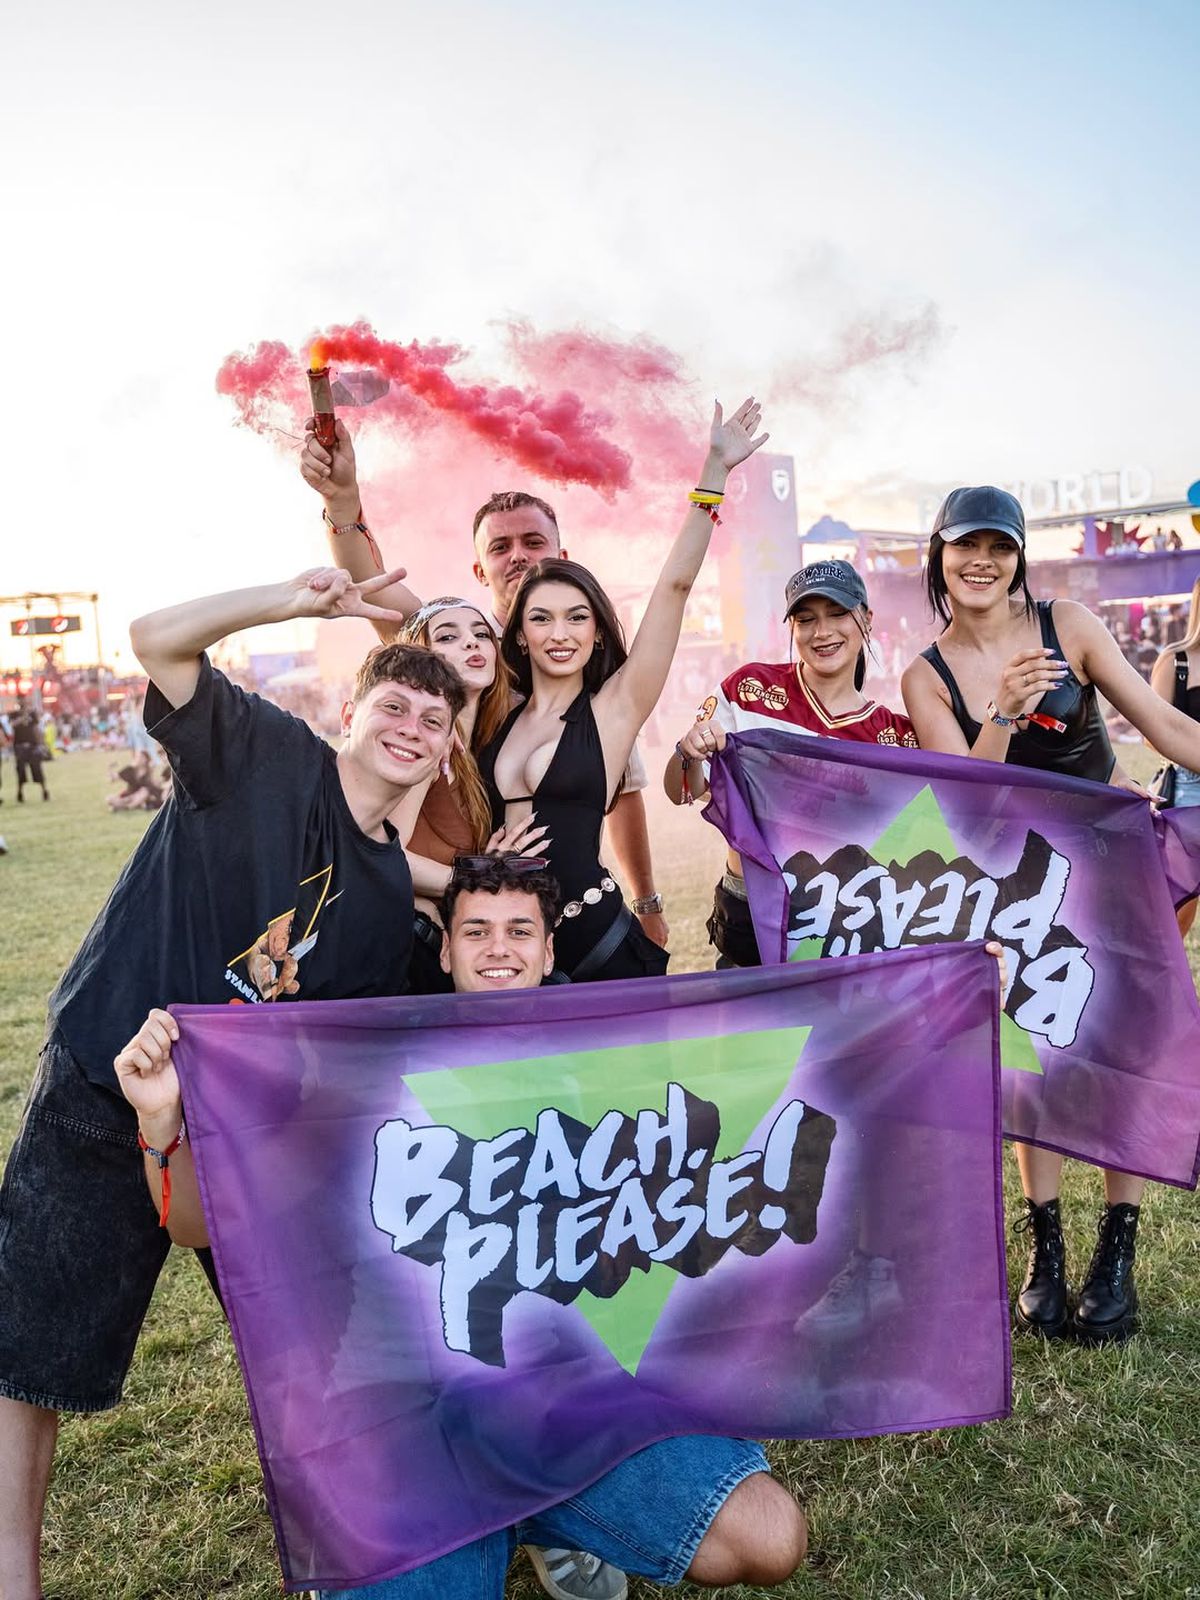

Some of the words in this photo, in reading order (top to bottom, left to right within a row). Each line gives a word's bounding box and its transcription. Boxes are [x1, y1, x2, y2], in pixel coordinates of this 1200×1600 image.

[1006, 463, 1152, 517] ORLD
[880, 735, 894, 743] LOS
[224, 968, 263, 1004] STANL
[371, 1081, 708, 1252] BEACH.
[441, 1100, 806, 1353] PLEASE!
